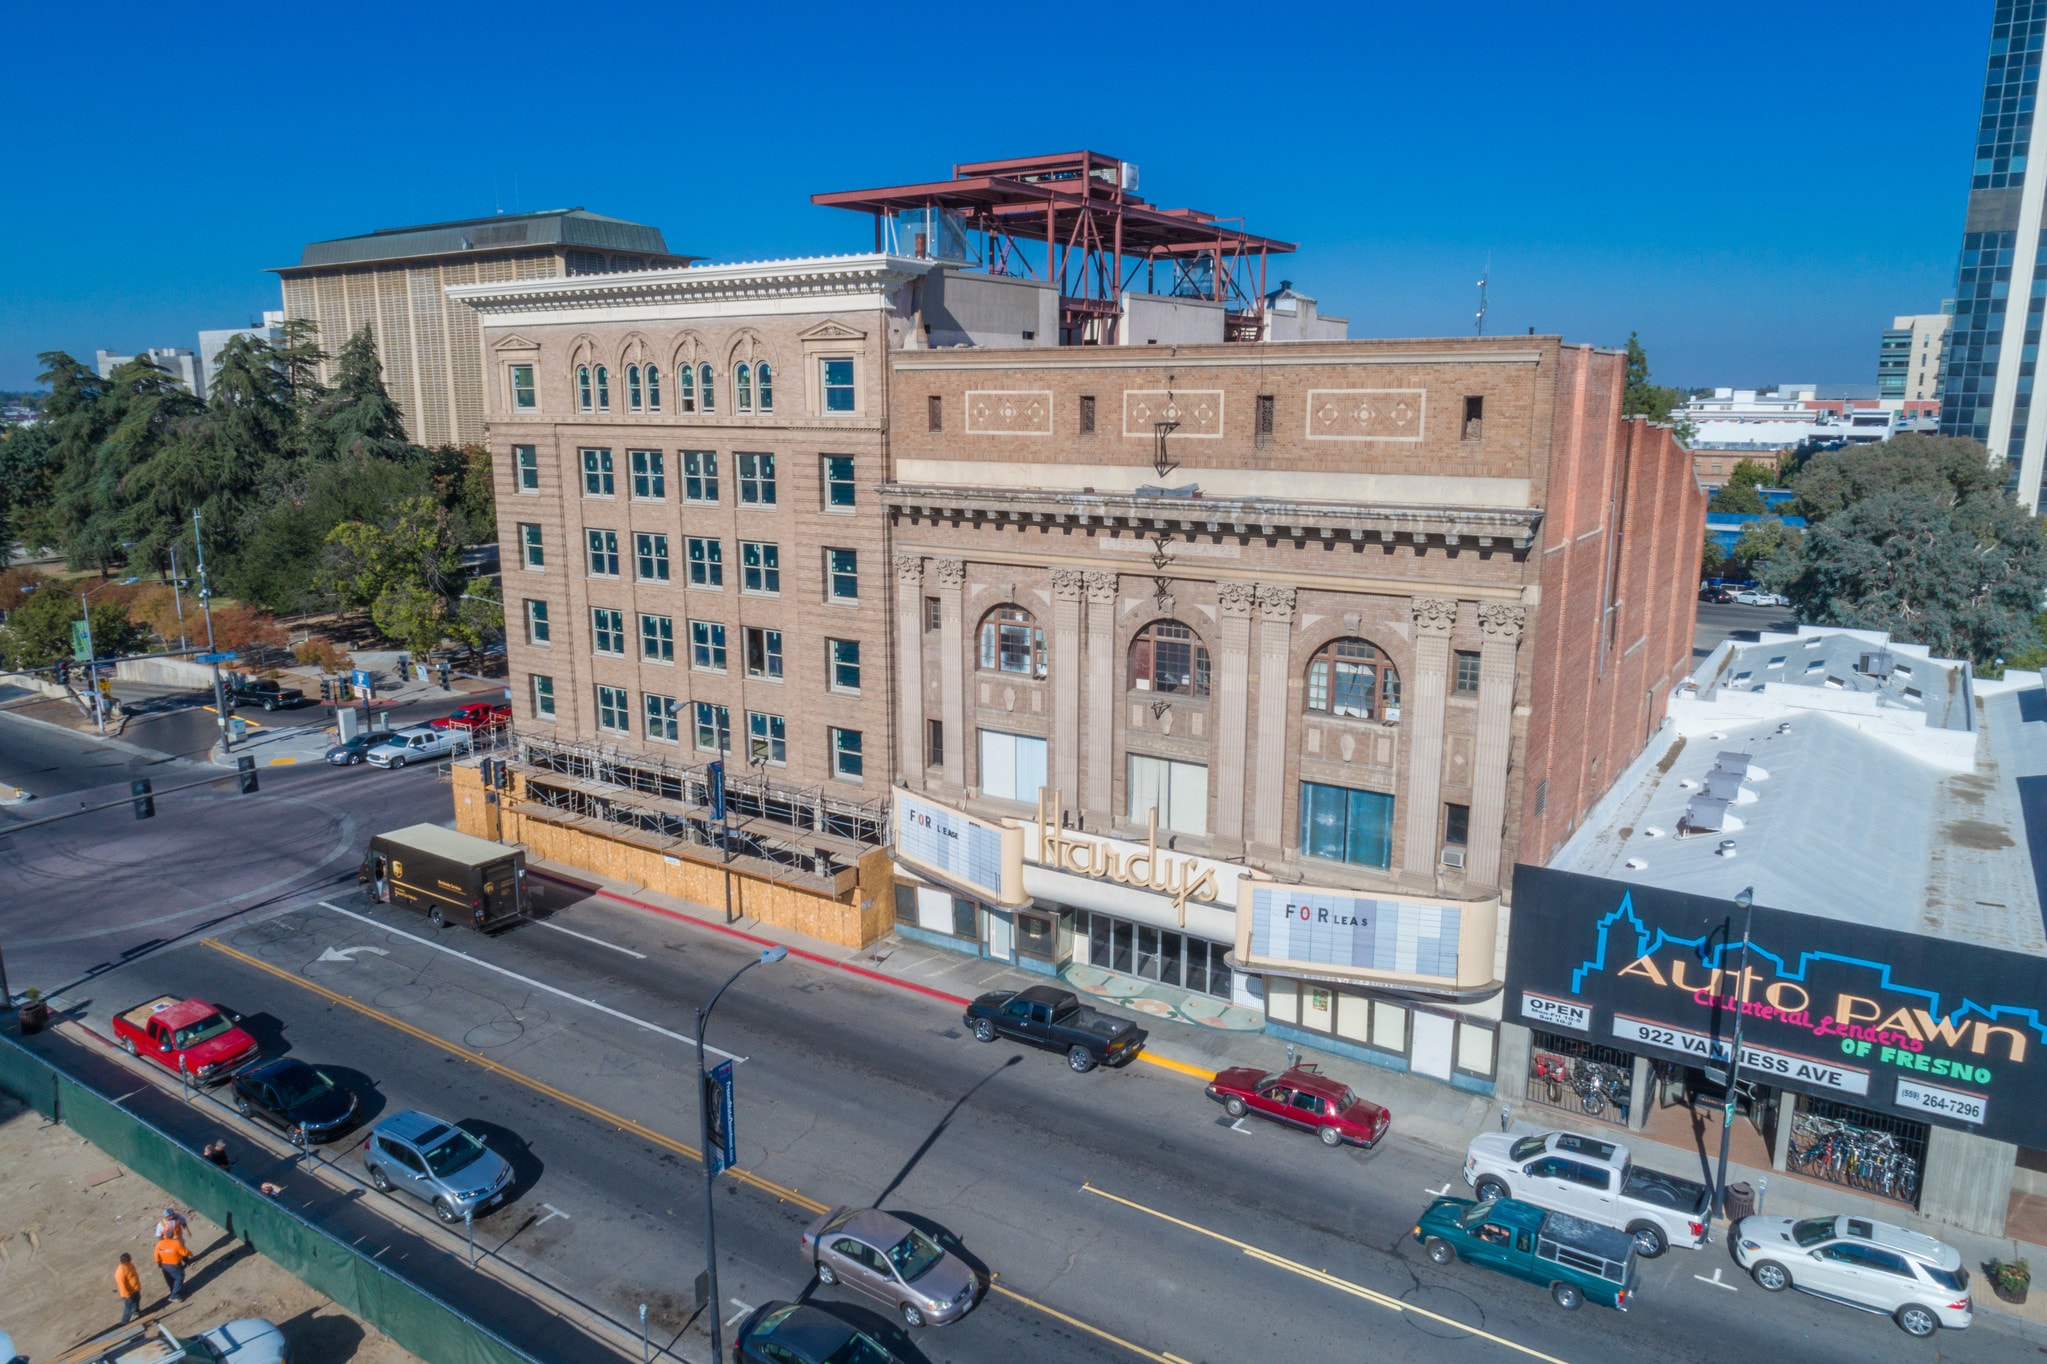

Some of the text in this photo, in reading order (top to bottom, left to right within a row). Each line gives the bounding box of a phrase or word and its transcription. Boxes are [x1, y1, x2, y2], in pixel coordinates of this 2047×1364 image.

[910, 809, 932, 829] FOR
[1285, 903, 1368, 926] FOR LEAS
[1530, 999, 1583, 1019] OPEN
[1813, 1015, 1924, 1052] Lenders
[1638, 1027, 1674, 1046] 922
[1681, 1035, 1724, 1057] VAN
[1796, 1064, 1843, 1087] AVE
[1841, 1038, 1992, 1084] OF FRESNO
[1901, 1088, 1980, 1117] (559) 264-7296
